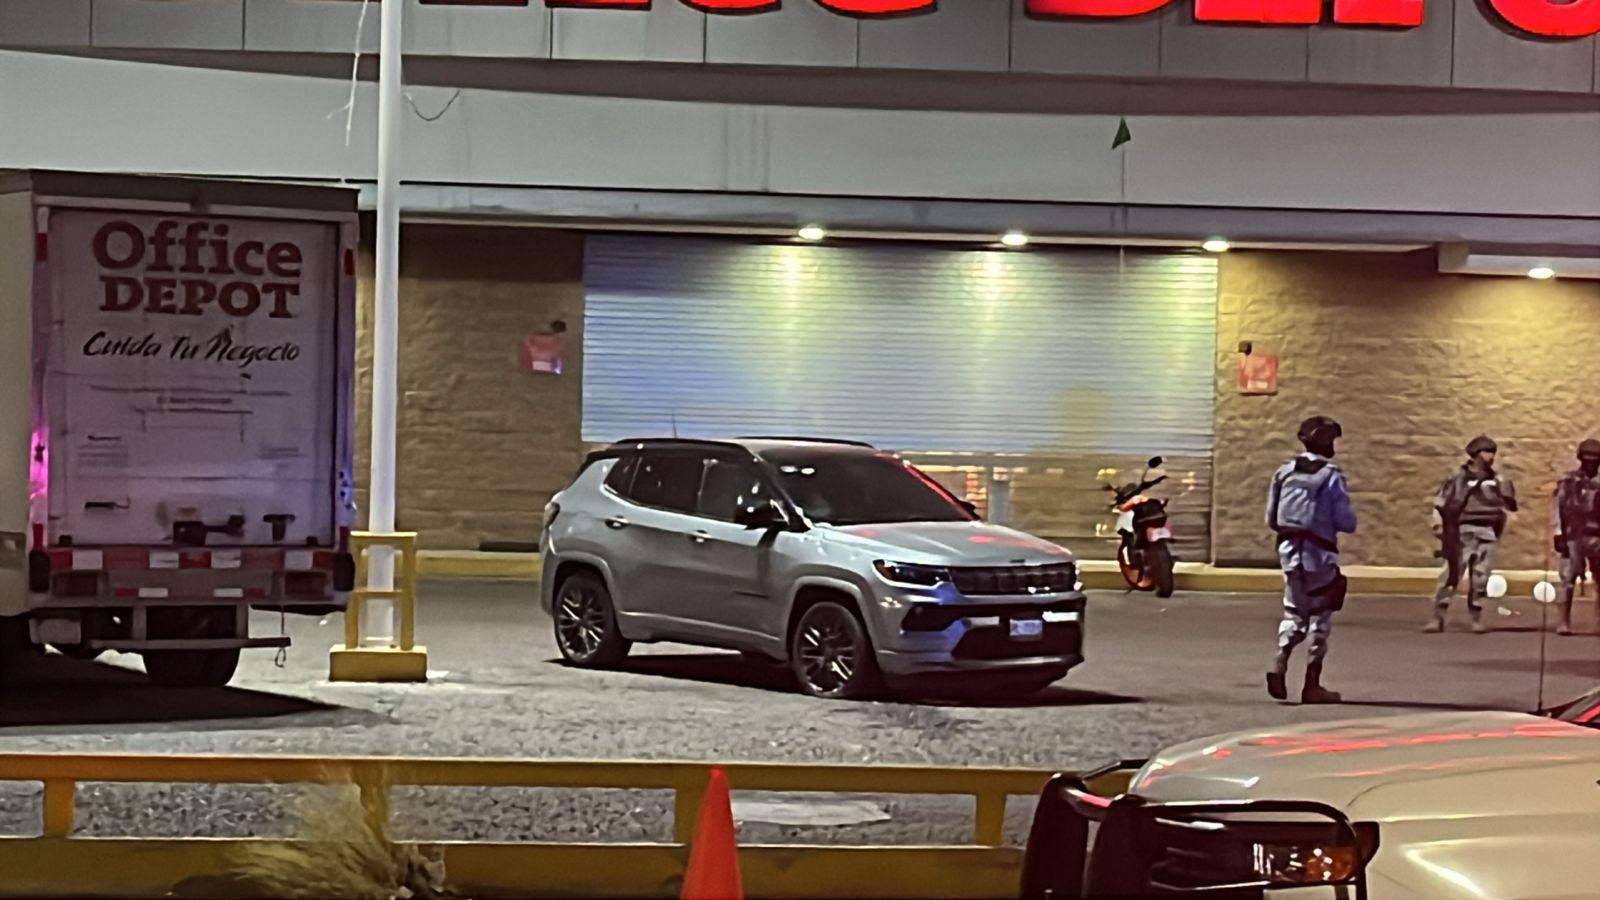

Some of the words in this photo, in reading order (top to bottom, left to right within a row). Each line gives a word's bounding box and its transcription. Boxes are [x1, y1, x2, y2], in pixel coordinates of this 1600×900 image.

[92, 220, 303, 277] Office
[100, 275, 300, 318] DEPOT
[83, 330, 162, 357] Cuida
[169, 335, 199, 360] Tu
[204, 328, 300, 368] Negocio
